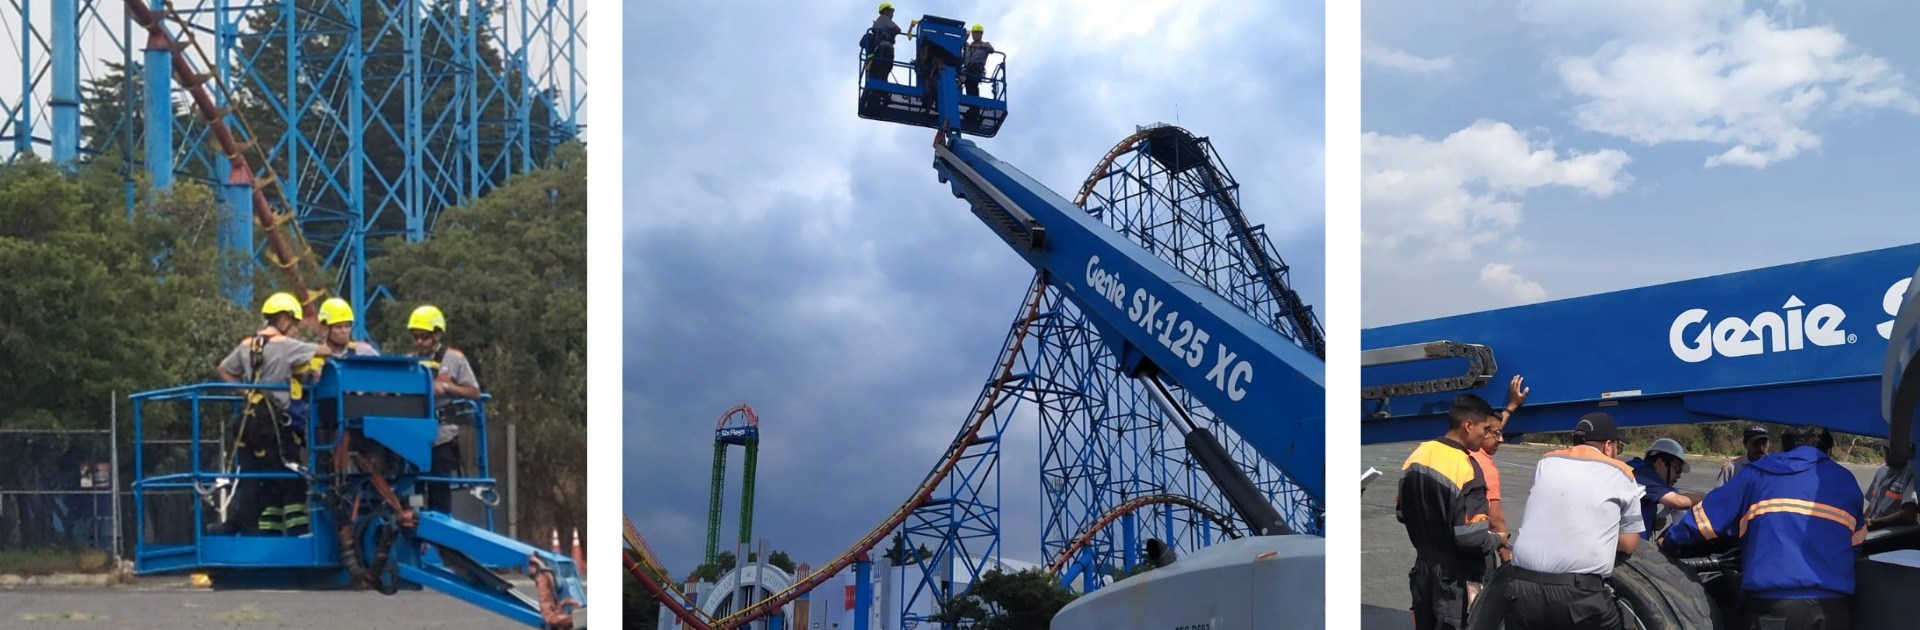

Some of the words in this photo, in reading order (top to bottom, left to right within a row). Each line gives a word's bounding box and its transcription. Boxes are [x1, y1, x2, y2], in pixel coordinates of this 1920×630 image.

[1086, 255, 1126, 310] Genie
[1128, 288, 1210, 368] SX-125
[1205, 343, 1253, 401] XC
[1669, 294, 1847, 363] Genie
